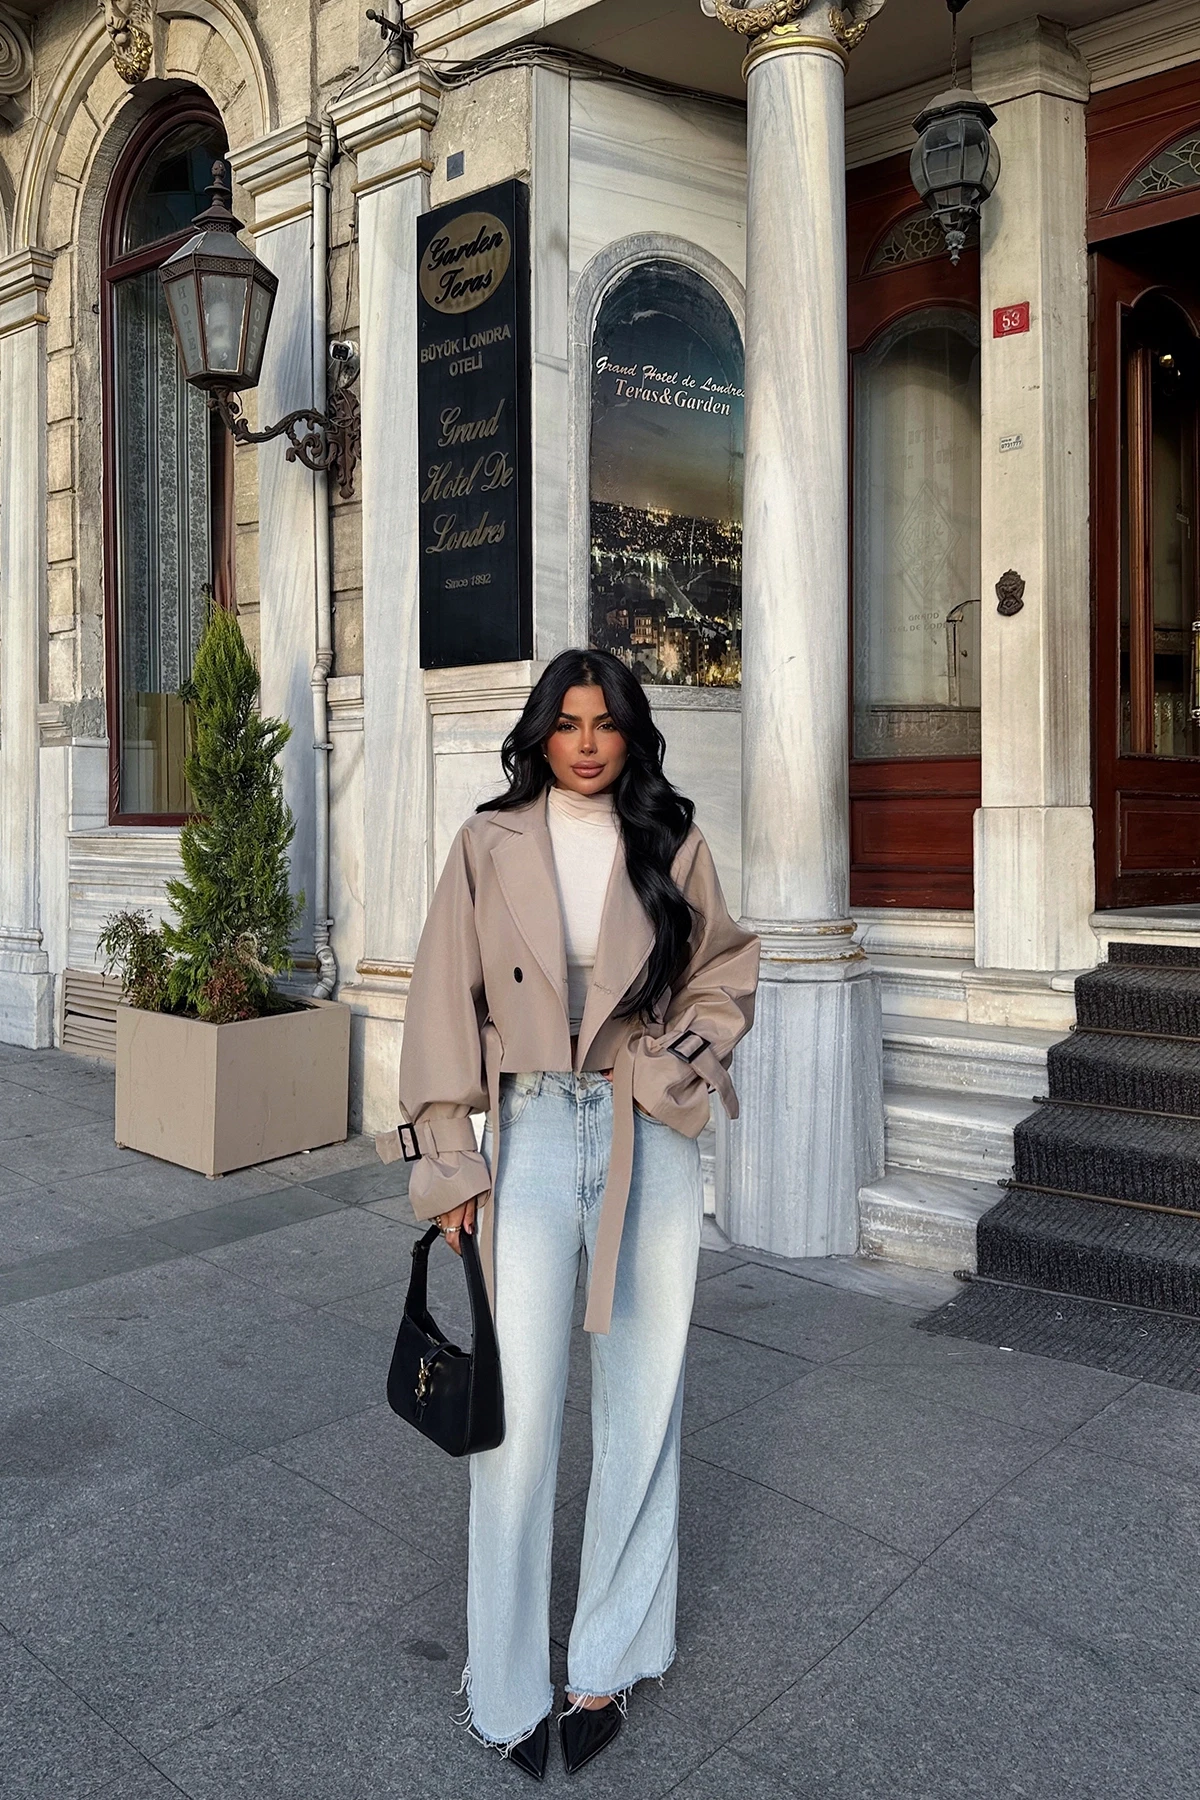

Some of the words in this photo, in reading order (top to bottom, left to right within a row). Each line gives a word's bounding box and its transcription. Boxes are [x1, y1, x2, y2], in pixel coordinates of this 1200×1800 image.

[427, 225, 503, 271] Garden
[435, 267, 493, 304] Teras
[247, 291, 264, 372] HOTEL
[1002, 311, 1020, 330] 53
[420, 341, 460, 364] BÜYÜK
[462, 324, 511, 352] LONDRA
[449, 351, 483, 377] OTELİ
[595, 356, 637, 377] Grand
[642, 365, 679, 385] Hotel
[681, 374, 697, 388] de
[615, 378, 731, 416] Teras&Garden
[437, 398, 506, 448] Grand
[421, 456, 484, 504] Hotel
[480, 451, 514, 492] De
[425, 511, 507, 554] Londres
[445, 577, 469, 590] Since
[470, 573, 492, 586] 1892
